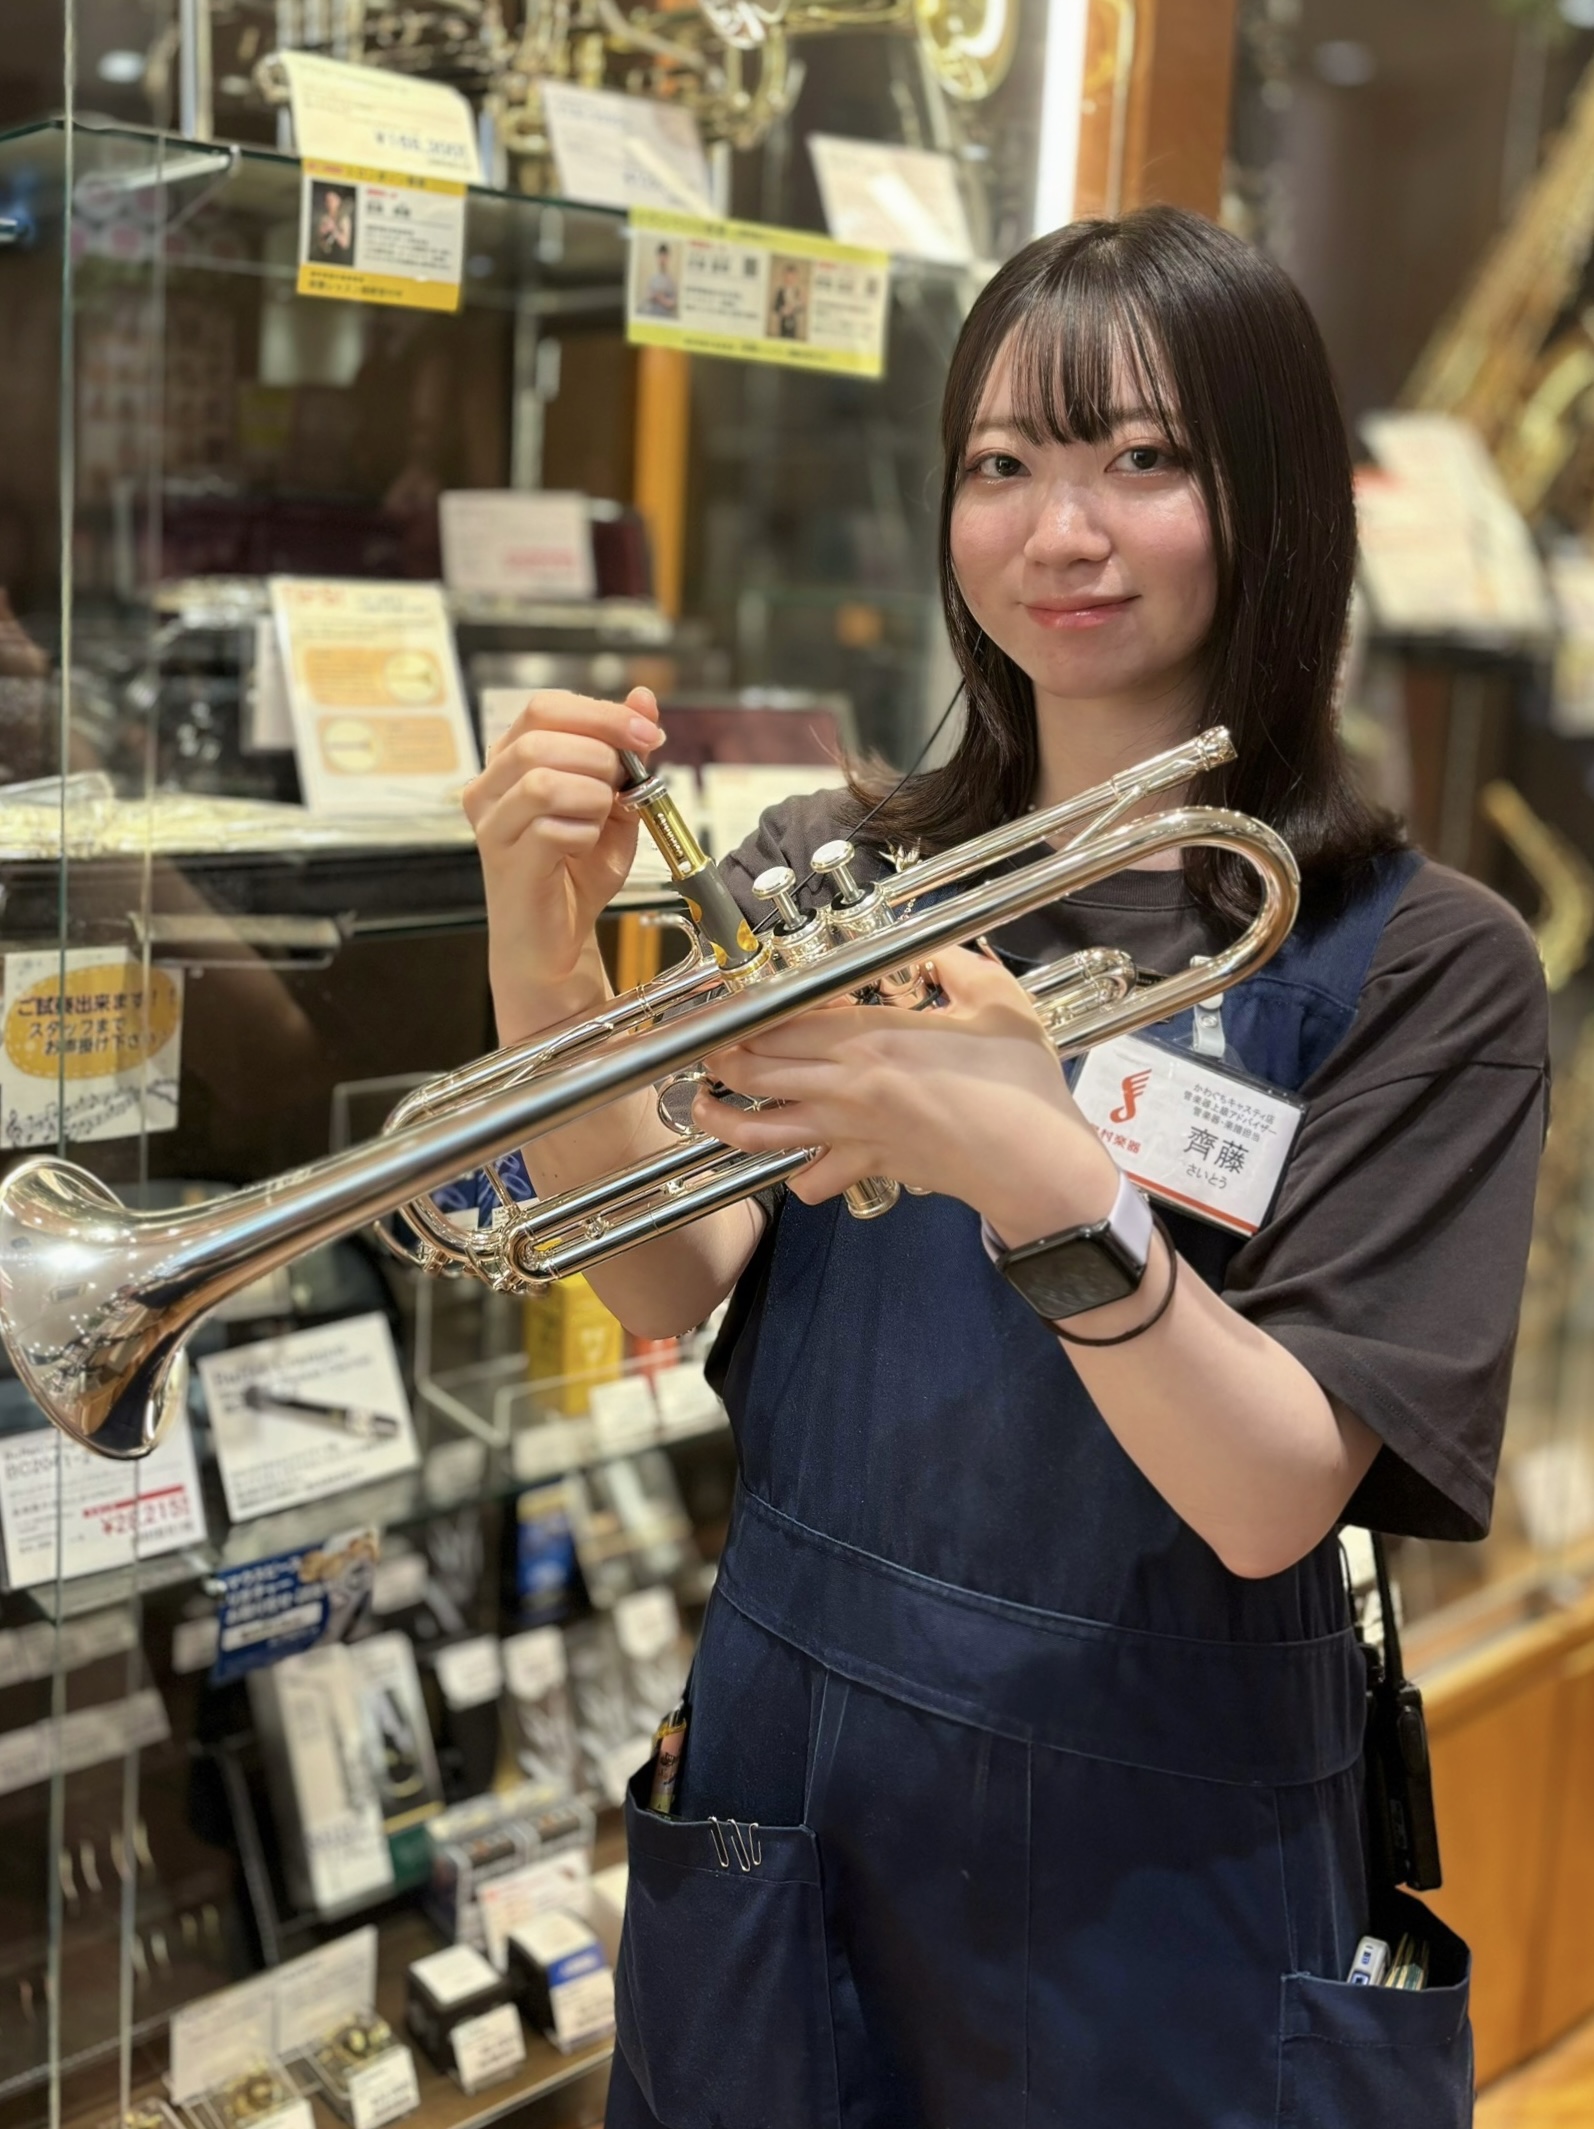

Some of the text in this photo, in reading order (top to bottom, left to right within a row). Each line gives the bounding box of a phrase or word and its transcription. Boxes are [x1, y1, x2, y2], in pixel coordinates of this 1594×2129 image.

[1193, 1084, 1276, 1125] かわぐちキャスティ店
[1096, 1126, 1141, 1154] 村楽器
[1186, 1164, 1228, 1189] さいとう
